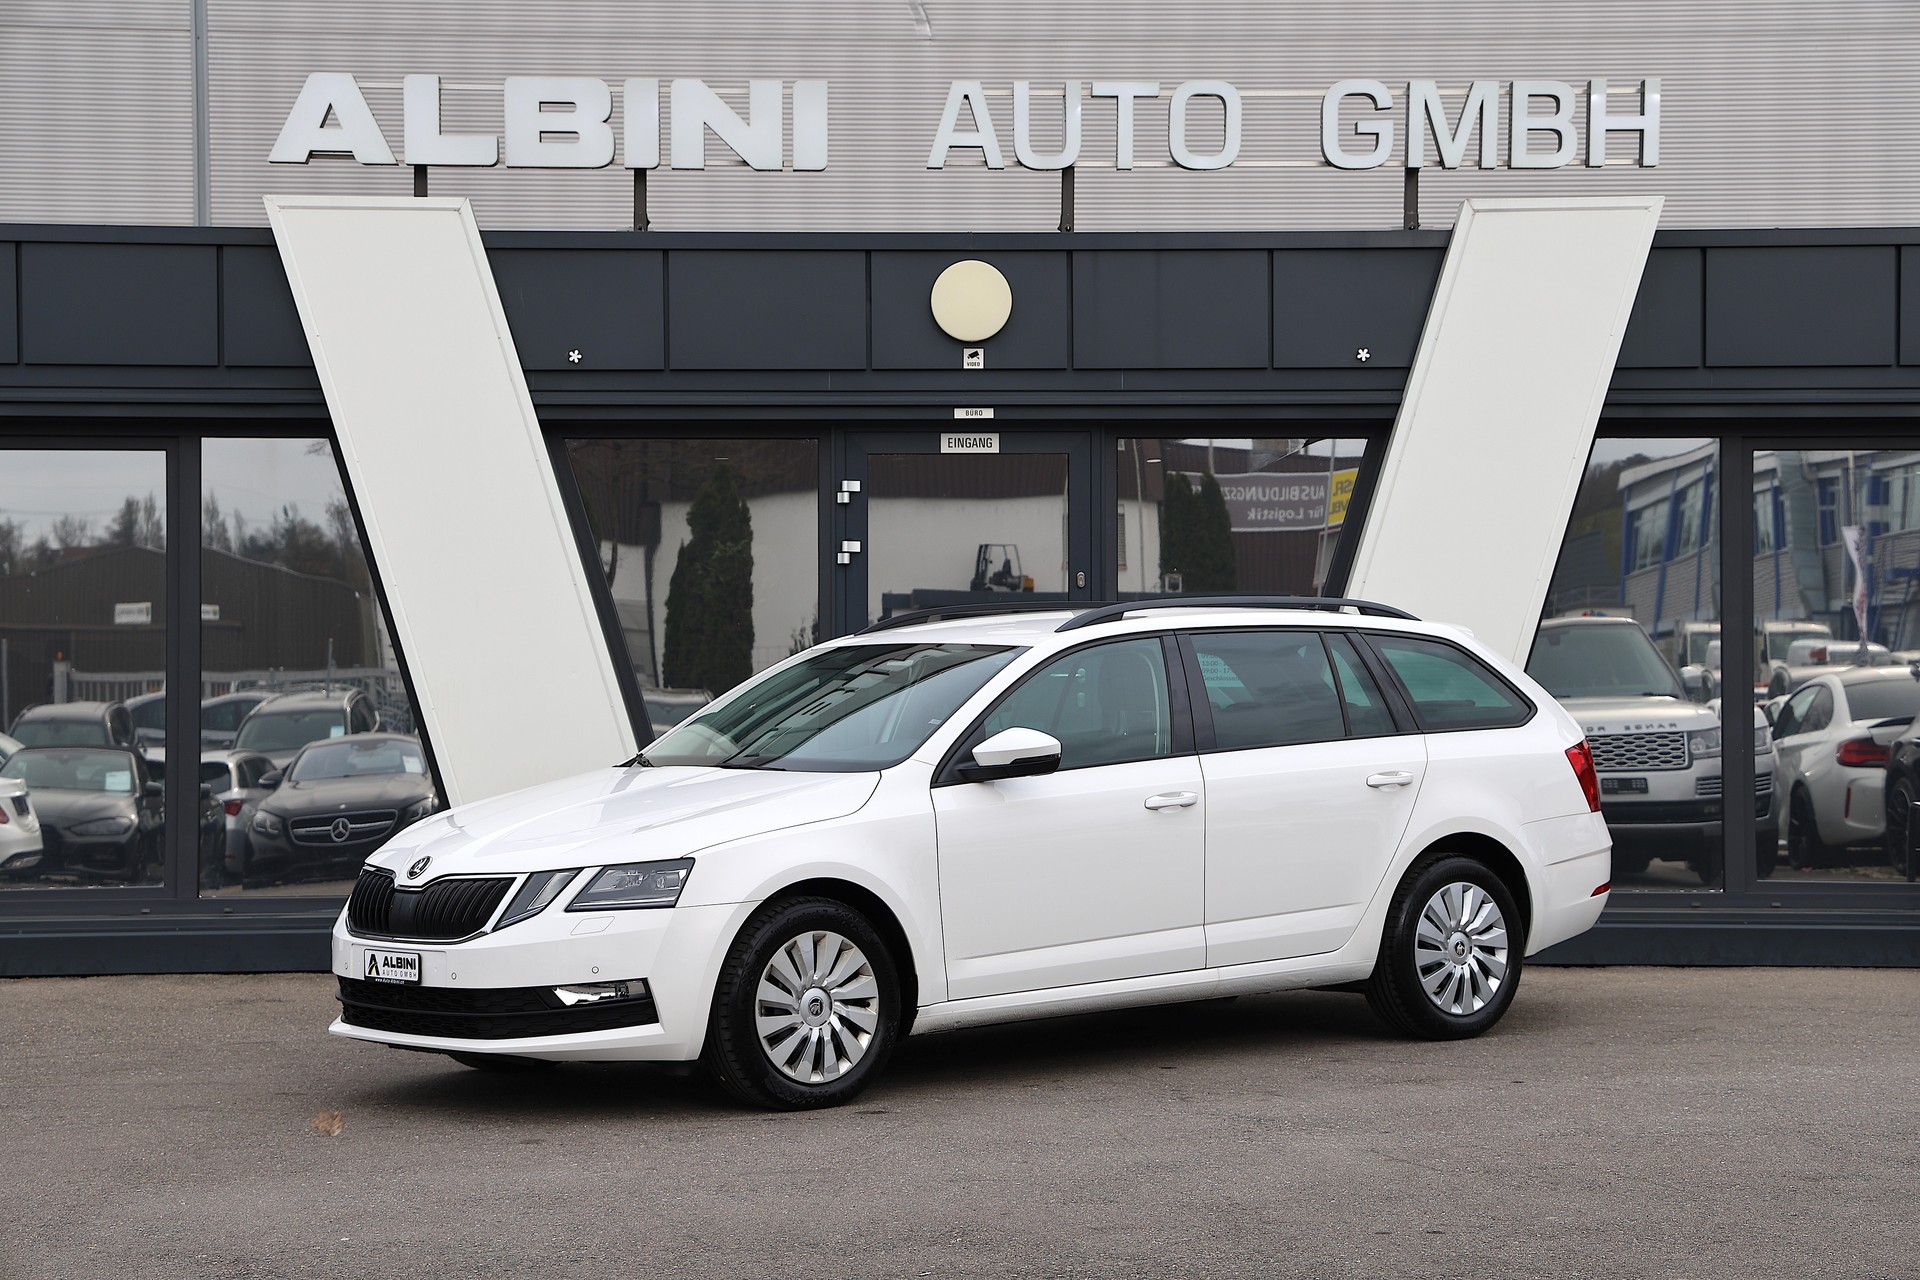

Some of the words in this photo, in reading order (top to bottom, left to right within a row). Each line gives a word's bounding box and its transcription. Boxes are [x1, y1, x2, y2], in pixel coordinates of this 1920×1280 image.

[267, 71, 829, 172] ALBINI
[926, 79, 1243, 172] AUTO
[1320, 77, 1662, 172] GMBH
[965, 409, 983, 417] BÜRO
[947, 437, 993, 449] EINGANG
[382, 956, 416, 970] ALBINI
[382, 969, 398, 977] AUTO
[400, 970, 417, 979] GMBH
